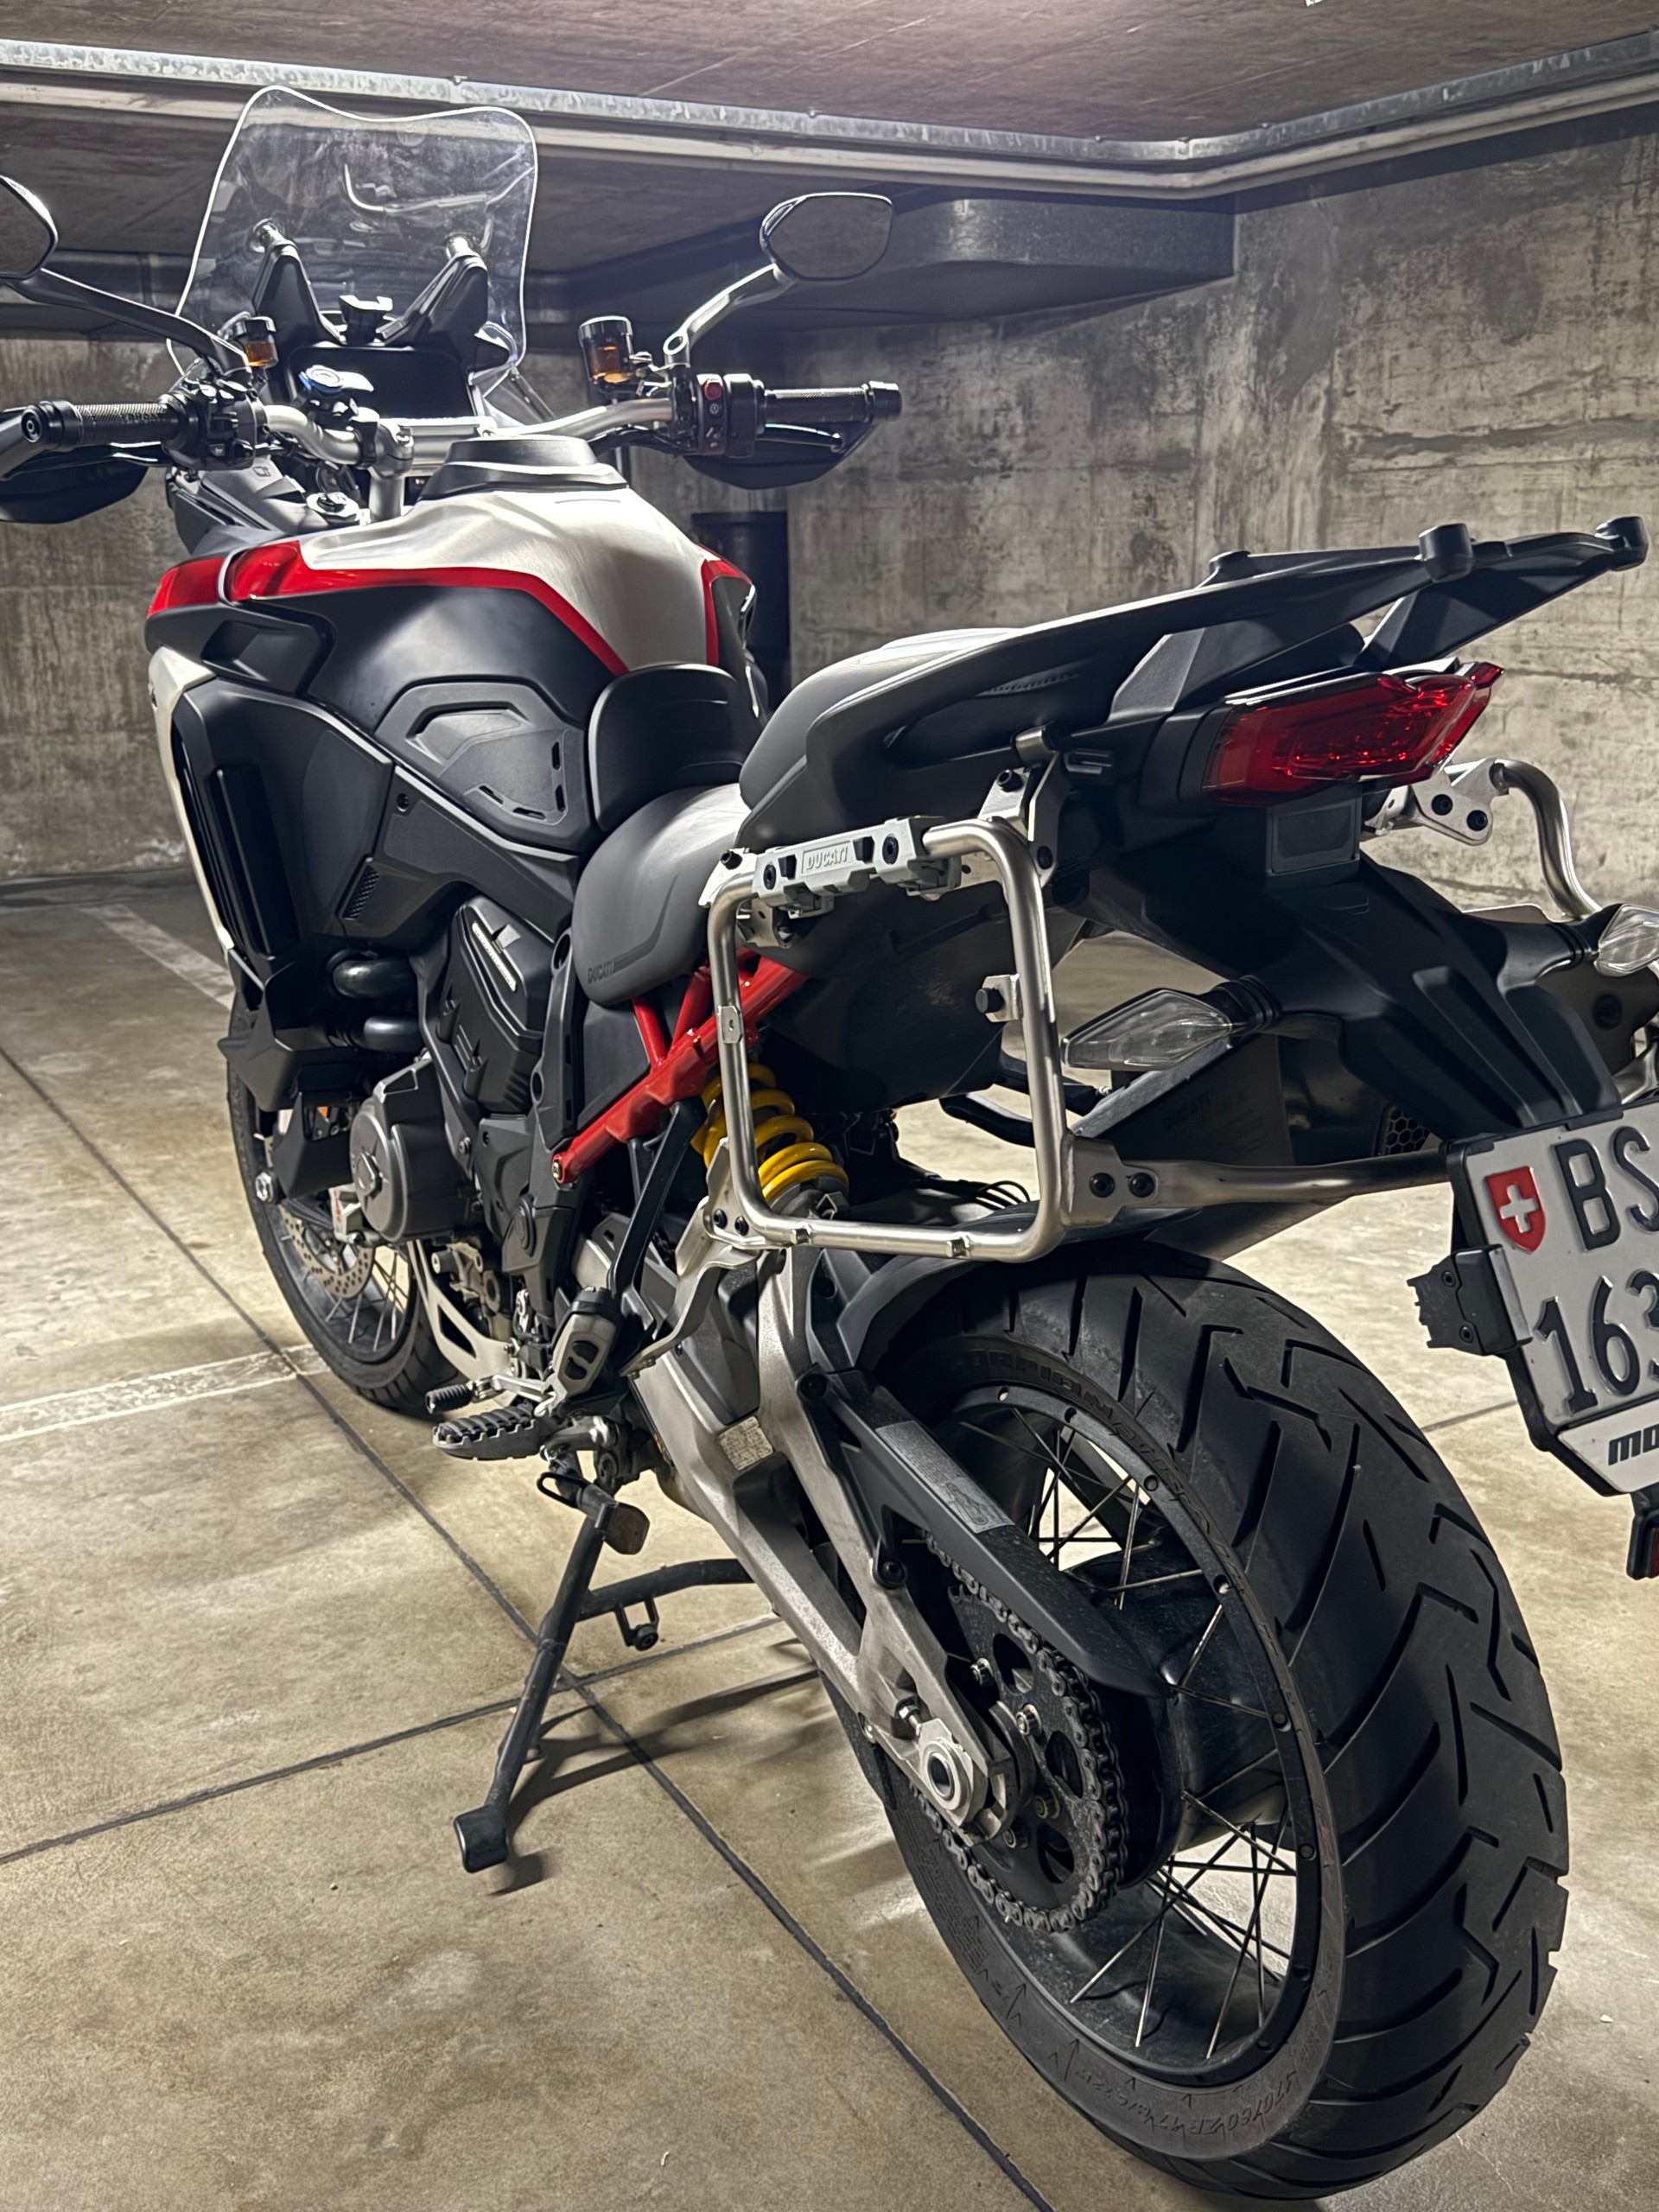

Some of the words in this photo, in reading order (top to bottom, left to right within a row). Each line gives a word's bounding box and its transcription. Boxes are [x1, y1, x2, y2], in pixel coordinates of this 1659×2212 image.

[806, 846, 849, 871] DUCATI
[588, 961, 614, 984] DUCATI
[1553, 1126, 1659, 1251] BS
